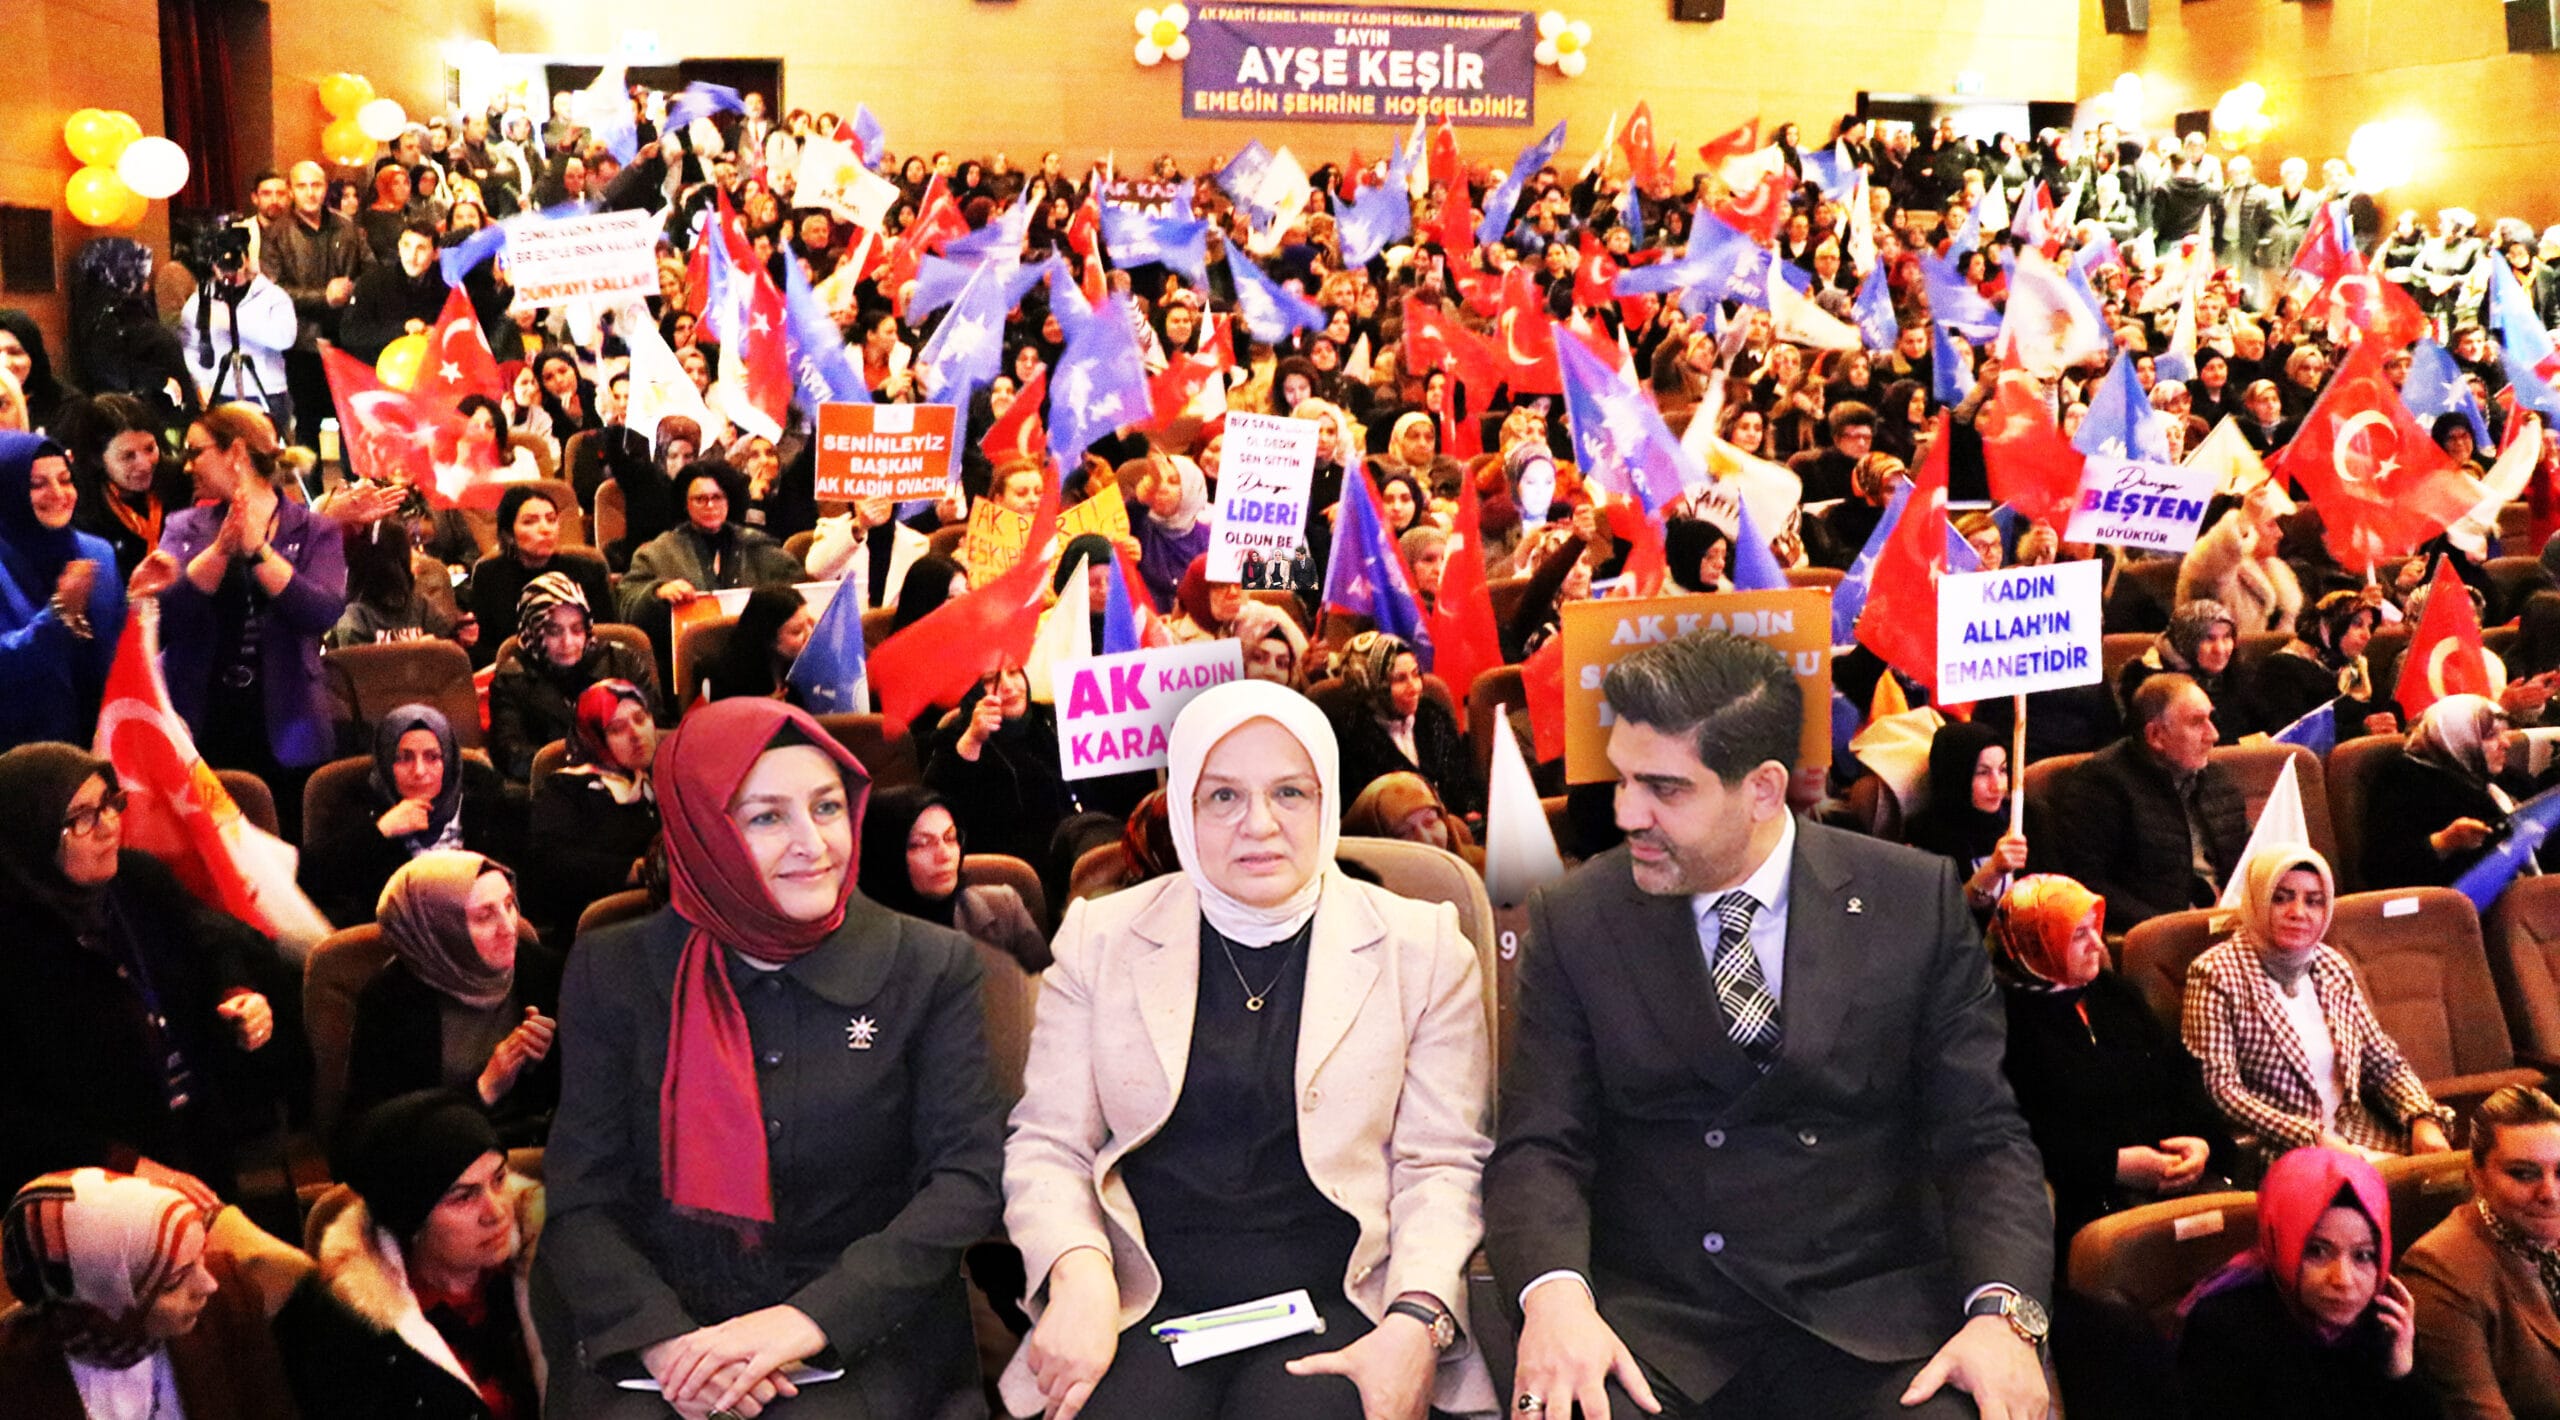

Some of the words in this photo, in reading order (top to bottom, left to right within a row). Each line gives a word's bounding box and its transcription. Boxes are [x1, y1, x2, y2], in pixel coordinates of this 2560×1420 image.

[1199, 8, 1217, 20] AK
[1257, 10, 1298, 22] GENEL
[1300, 11, 1349, 24] MERKEZ
[1352, 13, 1391, 25] KADIN
[1393, 14, 1444, 27] KOLLARI
[1334, 28, 1390, 47] SAYIN
[1237, 46, 1348, 92] AYŞE
[1359, 43, 1484, 95] KEŞİR
[1195, 88, 1278, 112] EMEĞİN
[1283, 91, 1375, 115] ŞEHRİNE
[822, 432, 946, 454] SENİNLEYİZ
[850, 456, 924, 478] BAŞKAN
[816, 477, 840, 494] AK
[843, 479, 893, 497] KADIN
[896, 477, 949, 496] OVACIK
[2080, 487, 2204, 523] BEŞTEN
[1225, 531, 1273, 547] OLDUN
[1276, 535, 1294, 549] BE
[1982, 574, 2054, 604] KADIN
[1611, 614, 1668, 646] AK
[1962, 609, 2071, 645] ALLAH'IN
[1944, 641, 2088, 685] EMANETİDİR
[1066, 662, 1152, 720] AK
[1158, 660, 1236, 693] KADIN
[1071, 723, 1170, 767] KARA
[1500, 930, 1517, 960] 9
